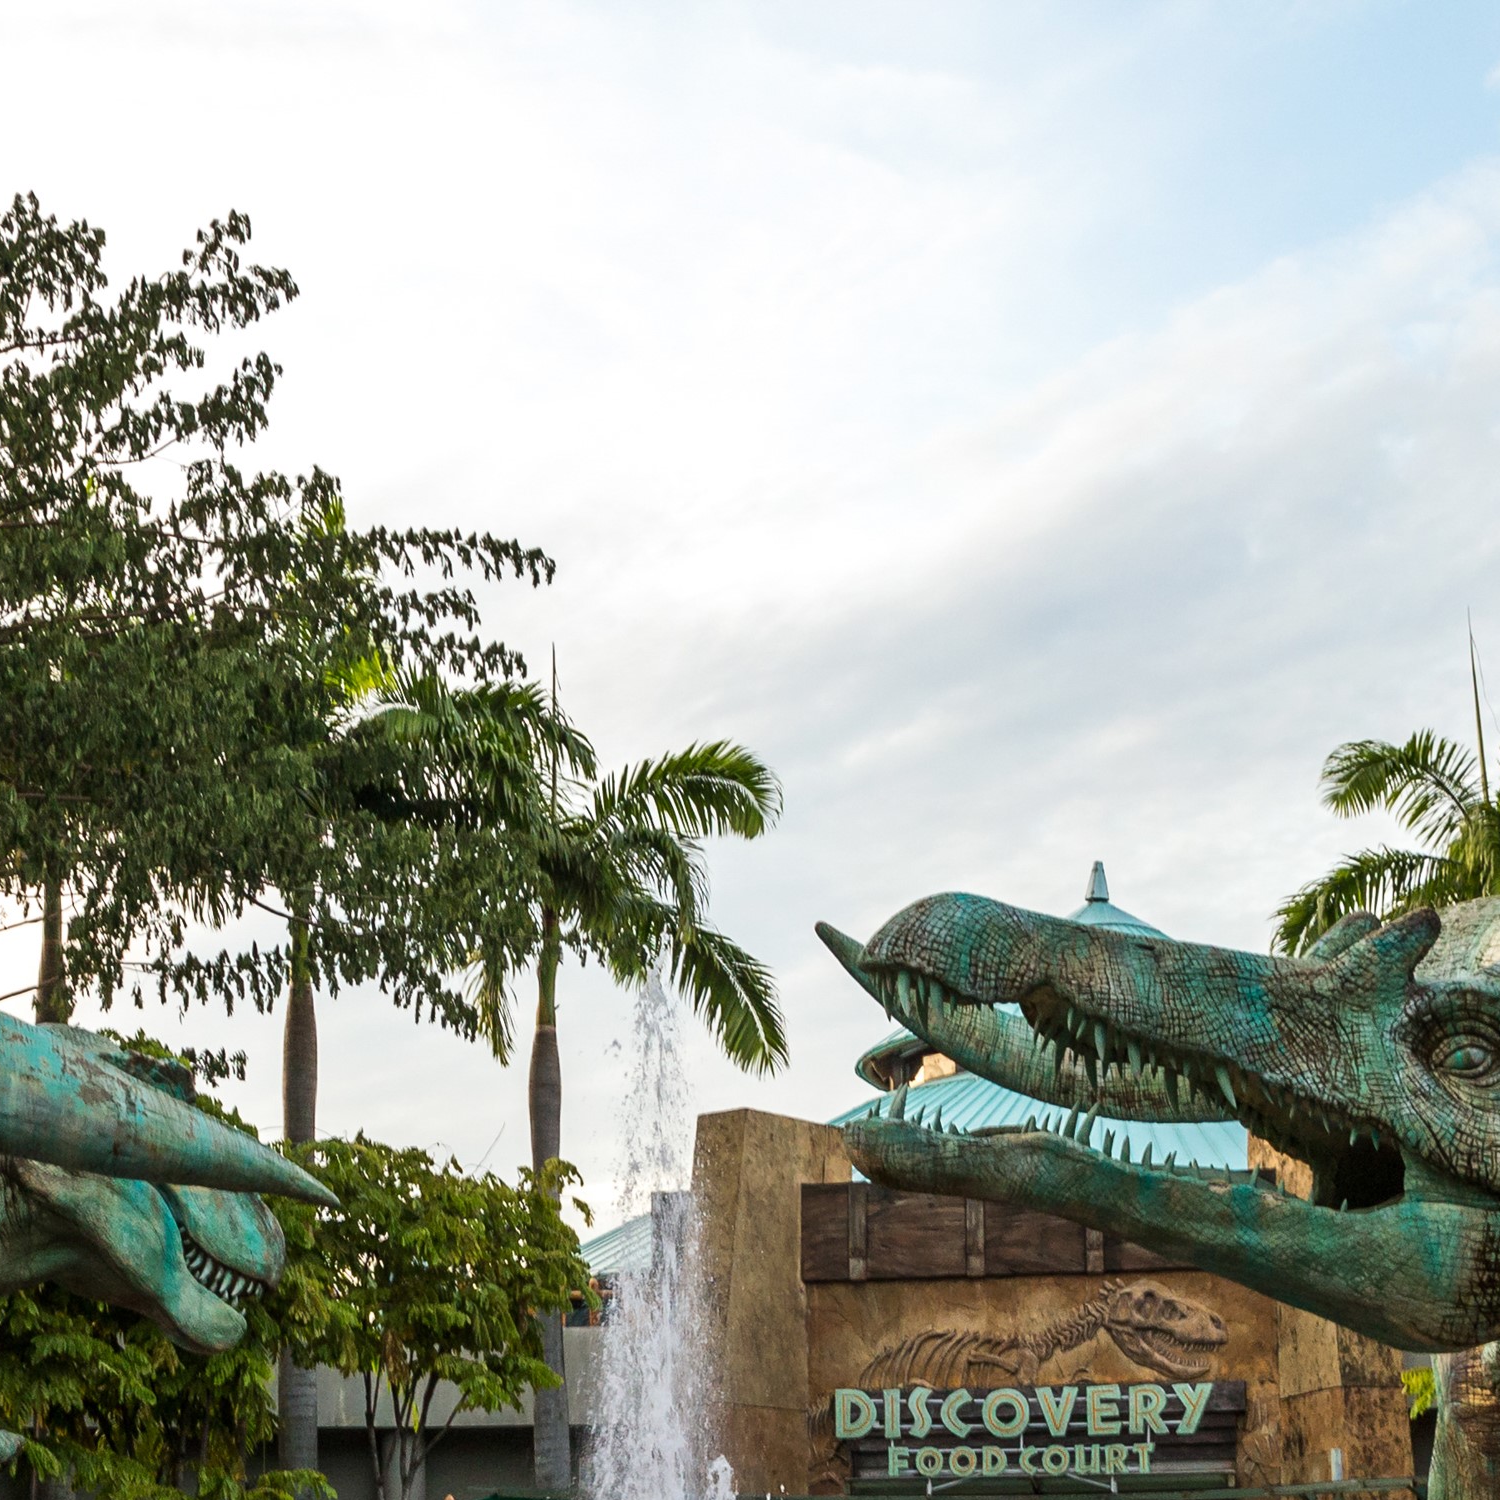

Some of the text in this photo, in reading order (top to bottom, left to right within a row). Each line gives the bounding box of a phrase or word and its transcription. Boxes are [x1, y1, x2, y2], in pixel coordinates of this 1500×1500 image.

[834, 1382, 1213, 1439] DISCOVERY
[887, 1442, 1156, 1477] FOOD COURT
